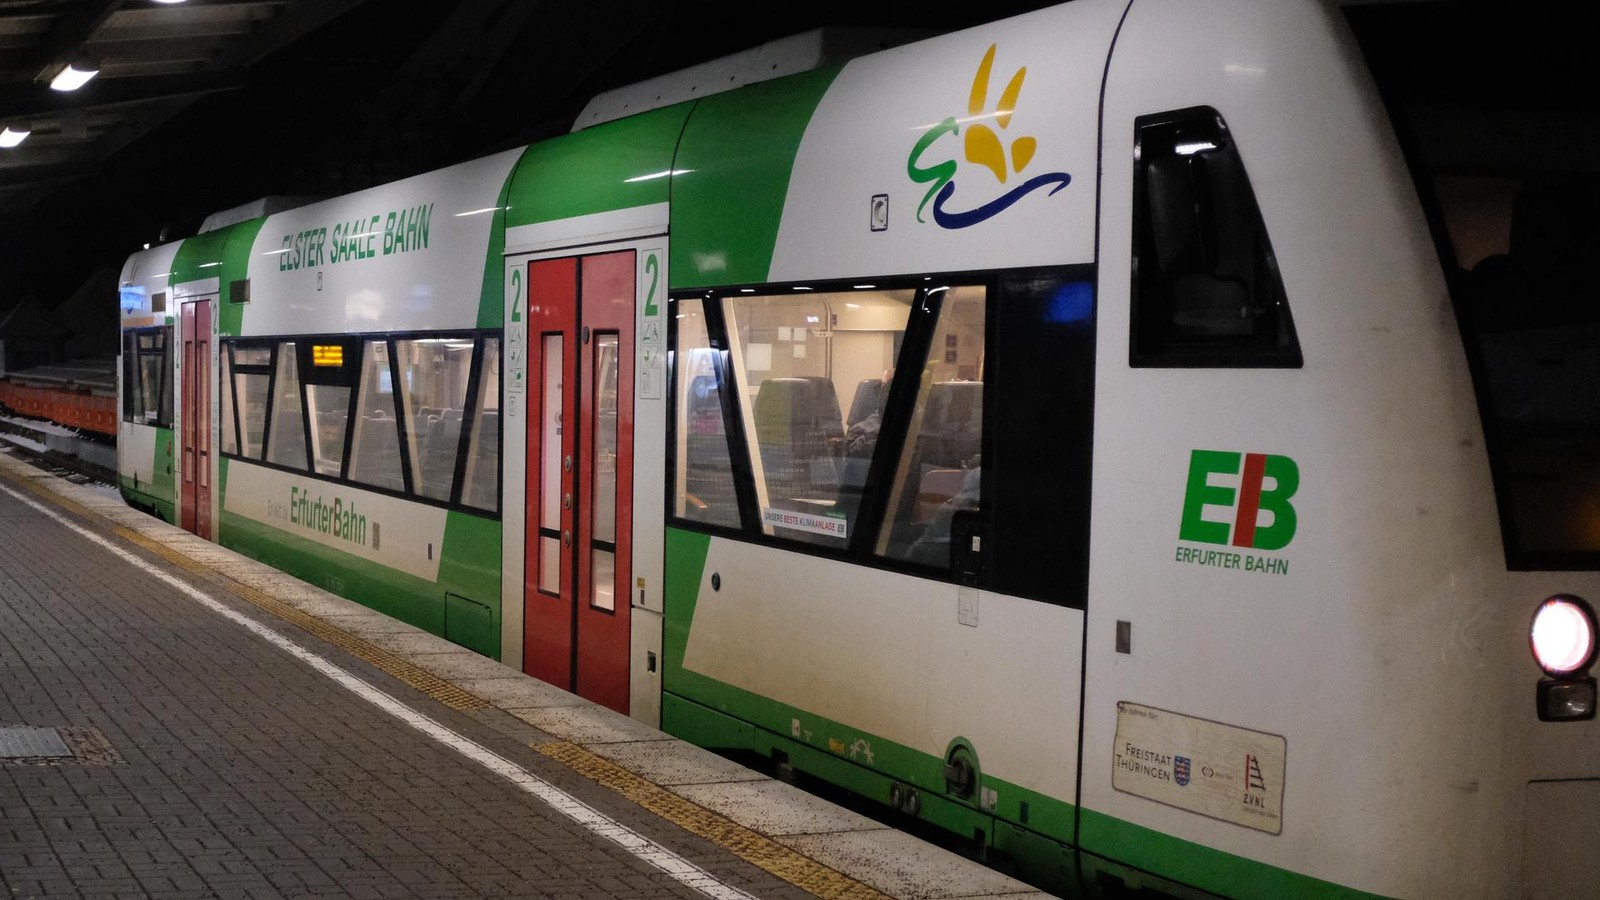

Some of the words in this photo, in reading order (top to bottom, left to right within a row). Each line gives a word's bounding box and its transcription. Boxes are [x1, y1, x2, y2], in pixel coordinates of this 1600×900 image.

[280, 227, 327, 271] ELSTER
[330, 215, 380, 264] SAALE
[383, 203, 434, 255] BAHN
[511, 269, 521, 322] 2
[644, 253, 659, 316] 2
[290, 486, 366, 546] ErfurterBahn
[765, 511, 783, 523] UNSERE
[783, 514, 799, 525] BESTE
[799, 517, 836, 532] KLIMAANLAGE
[1179, 449, 1300, 550] EB
[1175, 547, 1241, 570] ERFURTER
[1244, 555, 1289, 575] BAHN
[1116, 754, 1171, 781] THÜRINGEN
[1125, 742, 1172, 766] FREISTAAT
